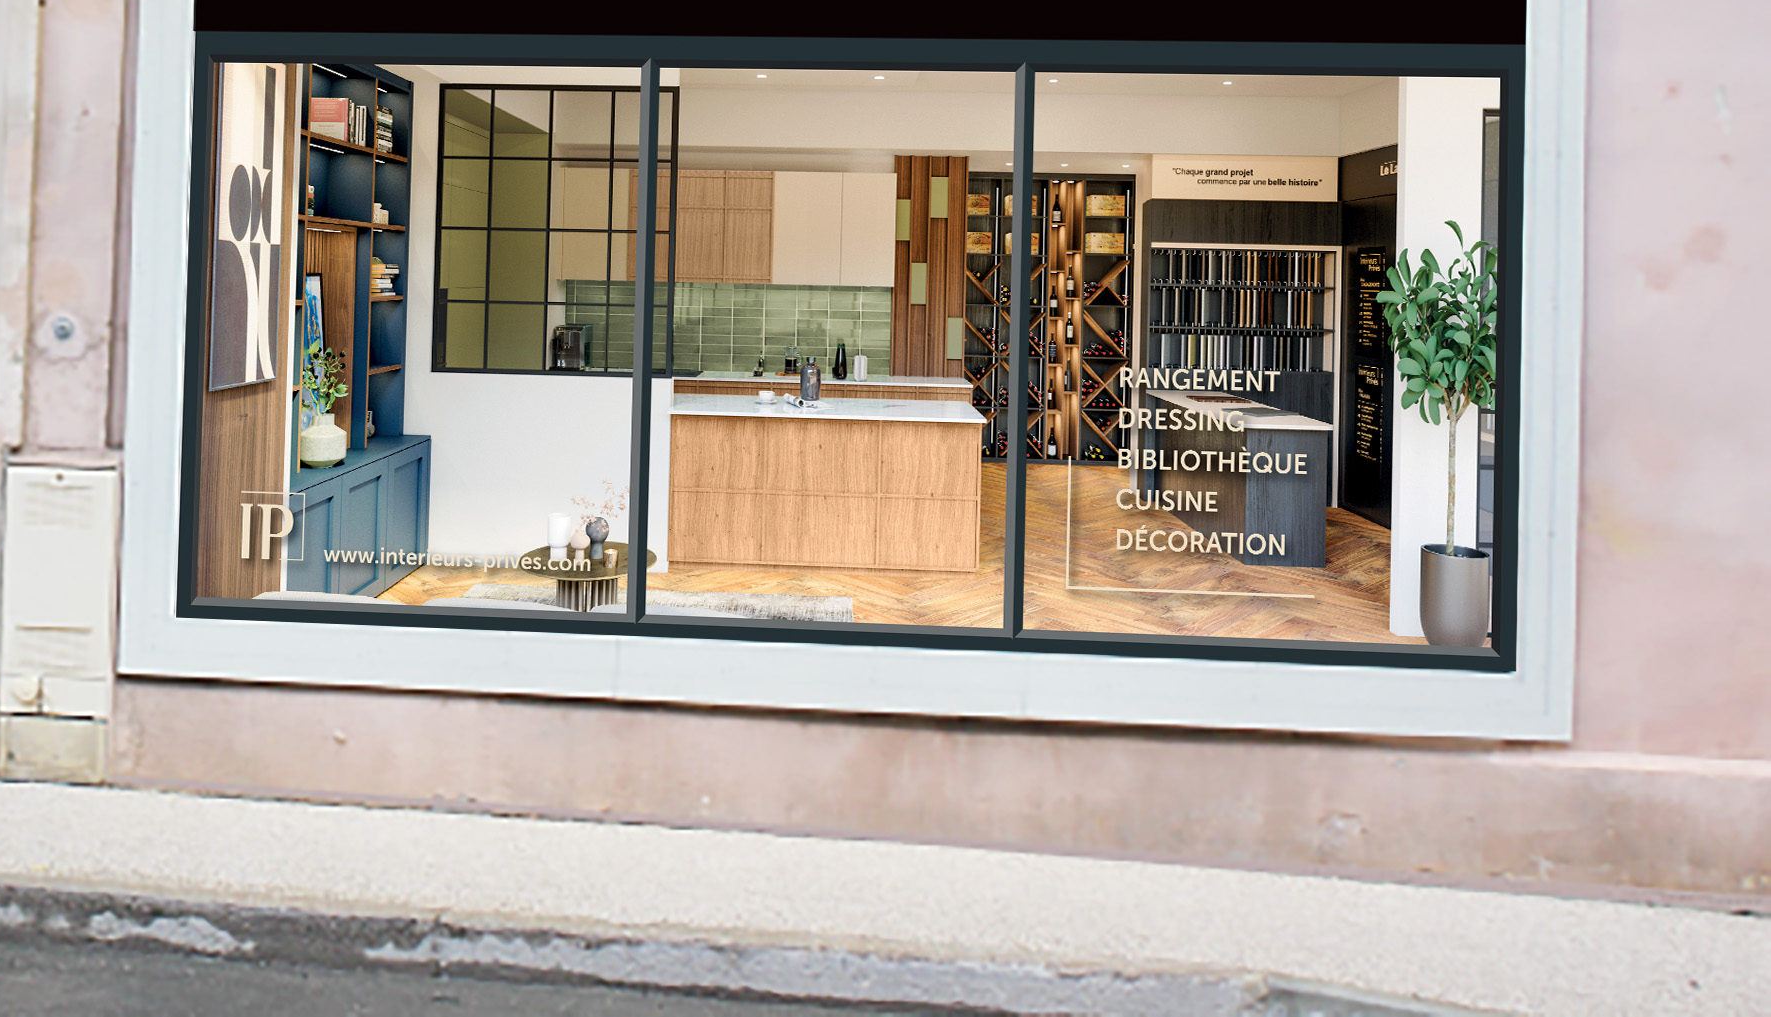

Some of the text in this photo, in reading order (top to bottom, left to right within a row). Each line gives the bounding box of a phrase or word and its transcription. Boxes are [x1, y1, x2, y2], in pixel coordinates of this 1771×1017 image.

[1205, 169, 1229, 178] grand
[1230, 169, 1254, 178] projet
[1238, 179, 1251, 187] par
[1267, 178, 1287, 187] belle
[1118, 366, 1281, 393] RANGEMENT
[1117, 407, 1246, 433] DRESSING
[1117, 447, 1309, 476] BIBLIOTHÈQUE
[1115, 488, 1219, 513] CUISINE
[240, 502, 295, 561] IP
[1115, 525, 1287, 557] DÉCORATION
[323, 547, 593, 573] www.interieurs-prives.com
